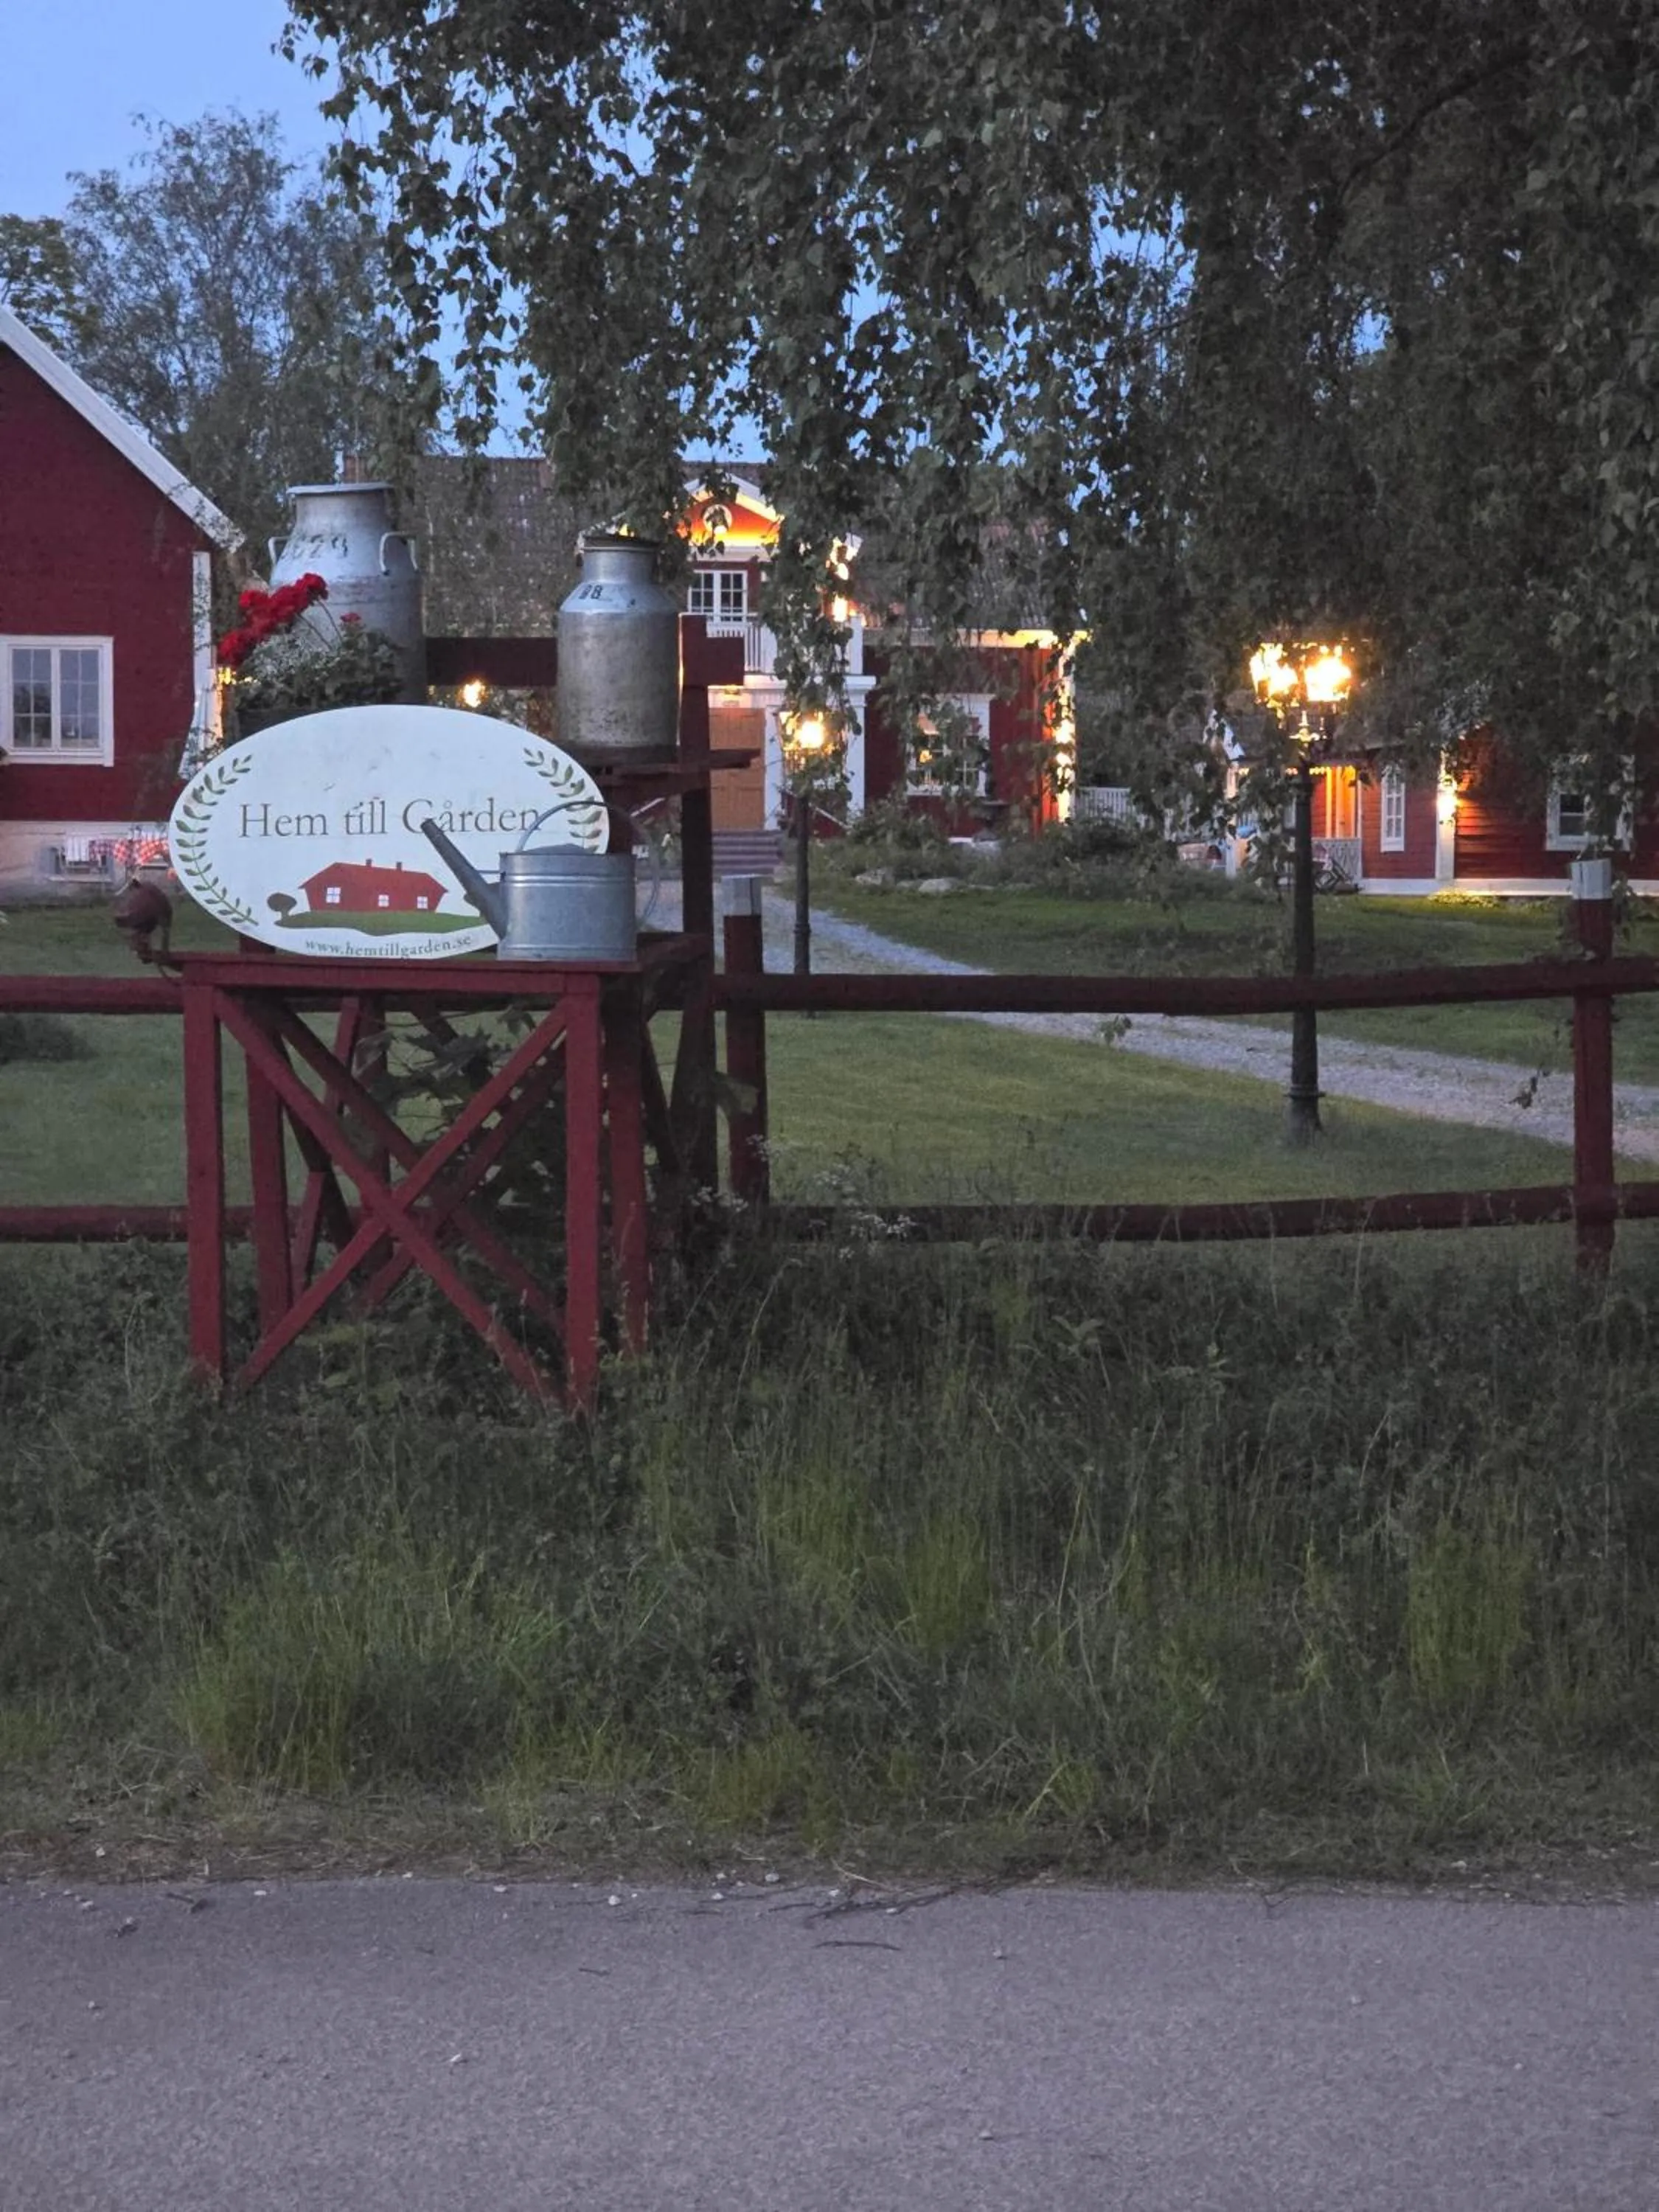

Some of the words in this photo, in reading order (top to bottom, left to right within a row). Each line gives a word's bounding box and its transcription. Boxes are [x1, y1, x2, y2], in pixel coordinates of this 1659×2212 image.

[238, 803, 330, 838] Hem
[344, 800, 388, 835] till
[402, 796, 542, 835] Gården
[305, 935, 472, 959] www.hemtillgarden.se
